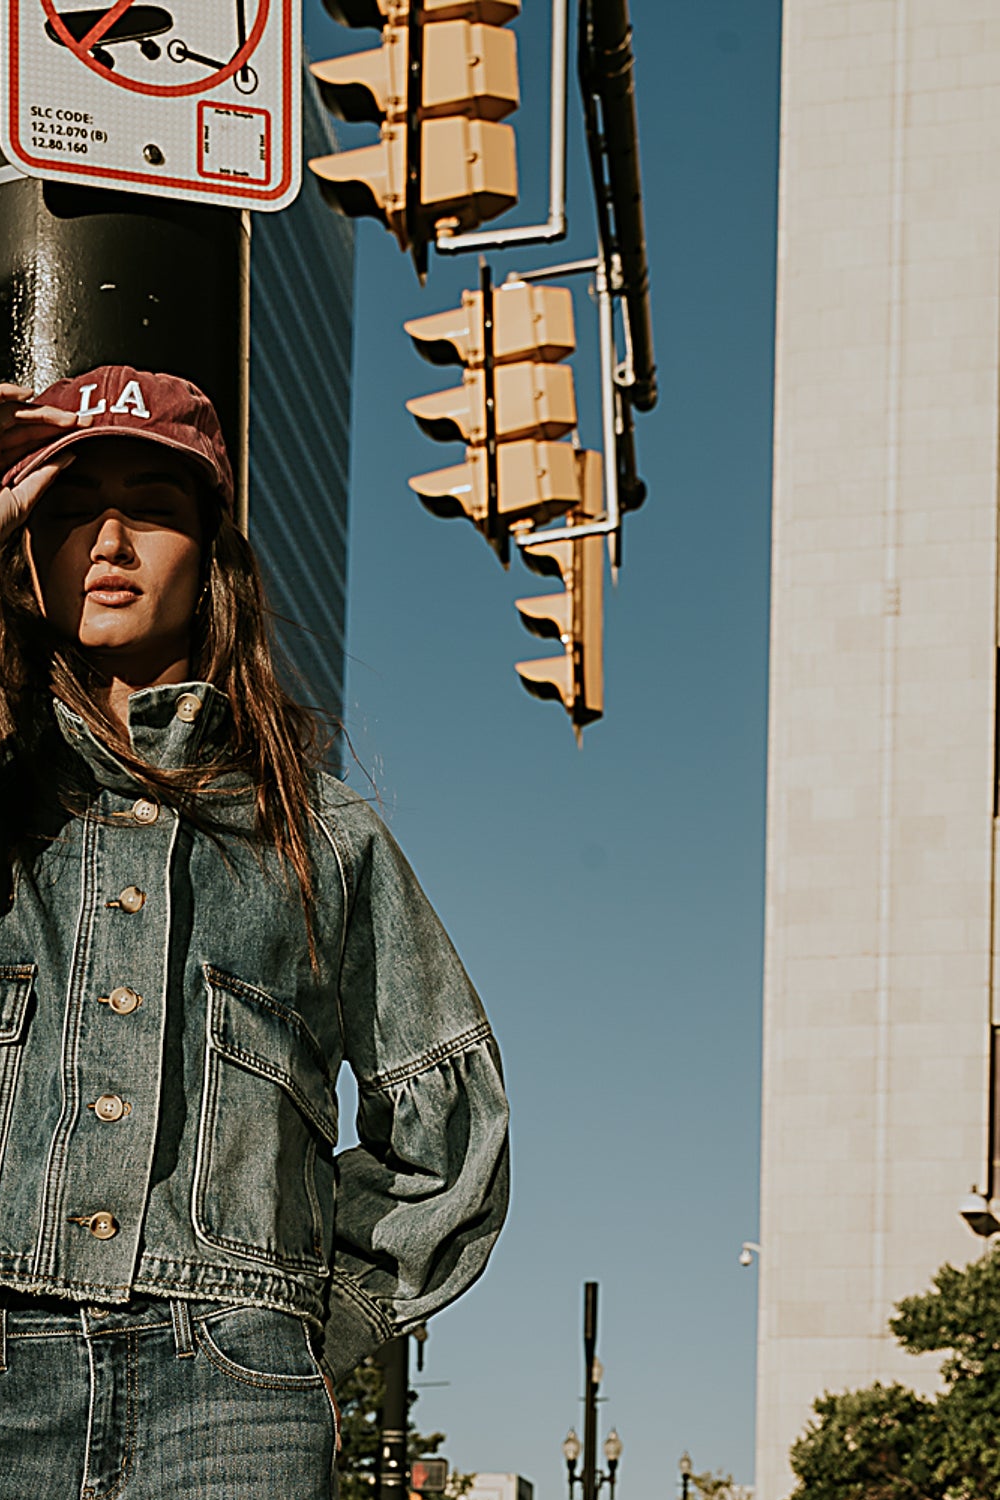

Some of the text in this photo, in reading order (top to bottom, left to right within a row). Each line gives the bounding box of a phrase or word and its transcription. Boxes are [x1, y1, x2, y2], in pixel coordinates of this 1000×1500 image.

[30, 106, 94, 125] SLC CODE:
[31, 121, 108, 144] 12.12.070 (B)
[31, 136, 88, 154] 12.80.160
[76, 380, 150, 419] LA
